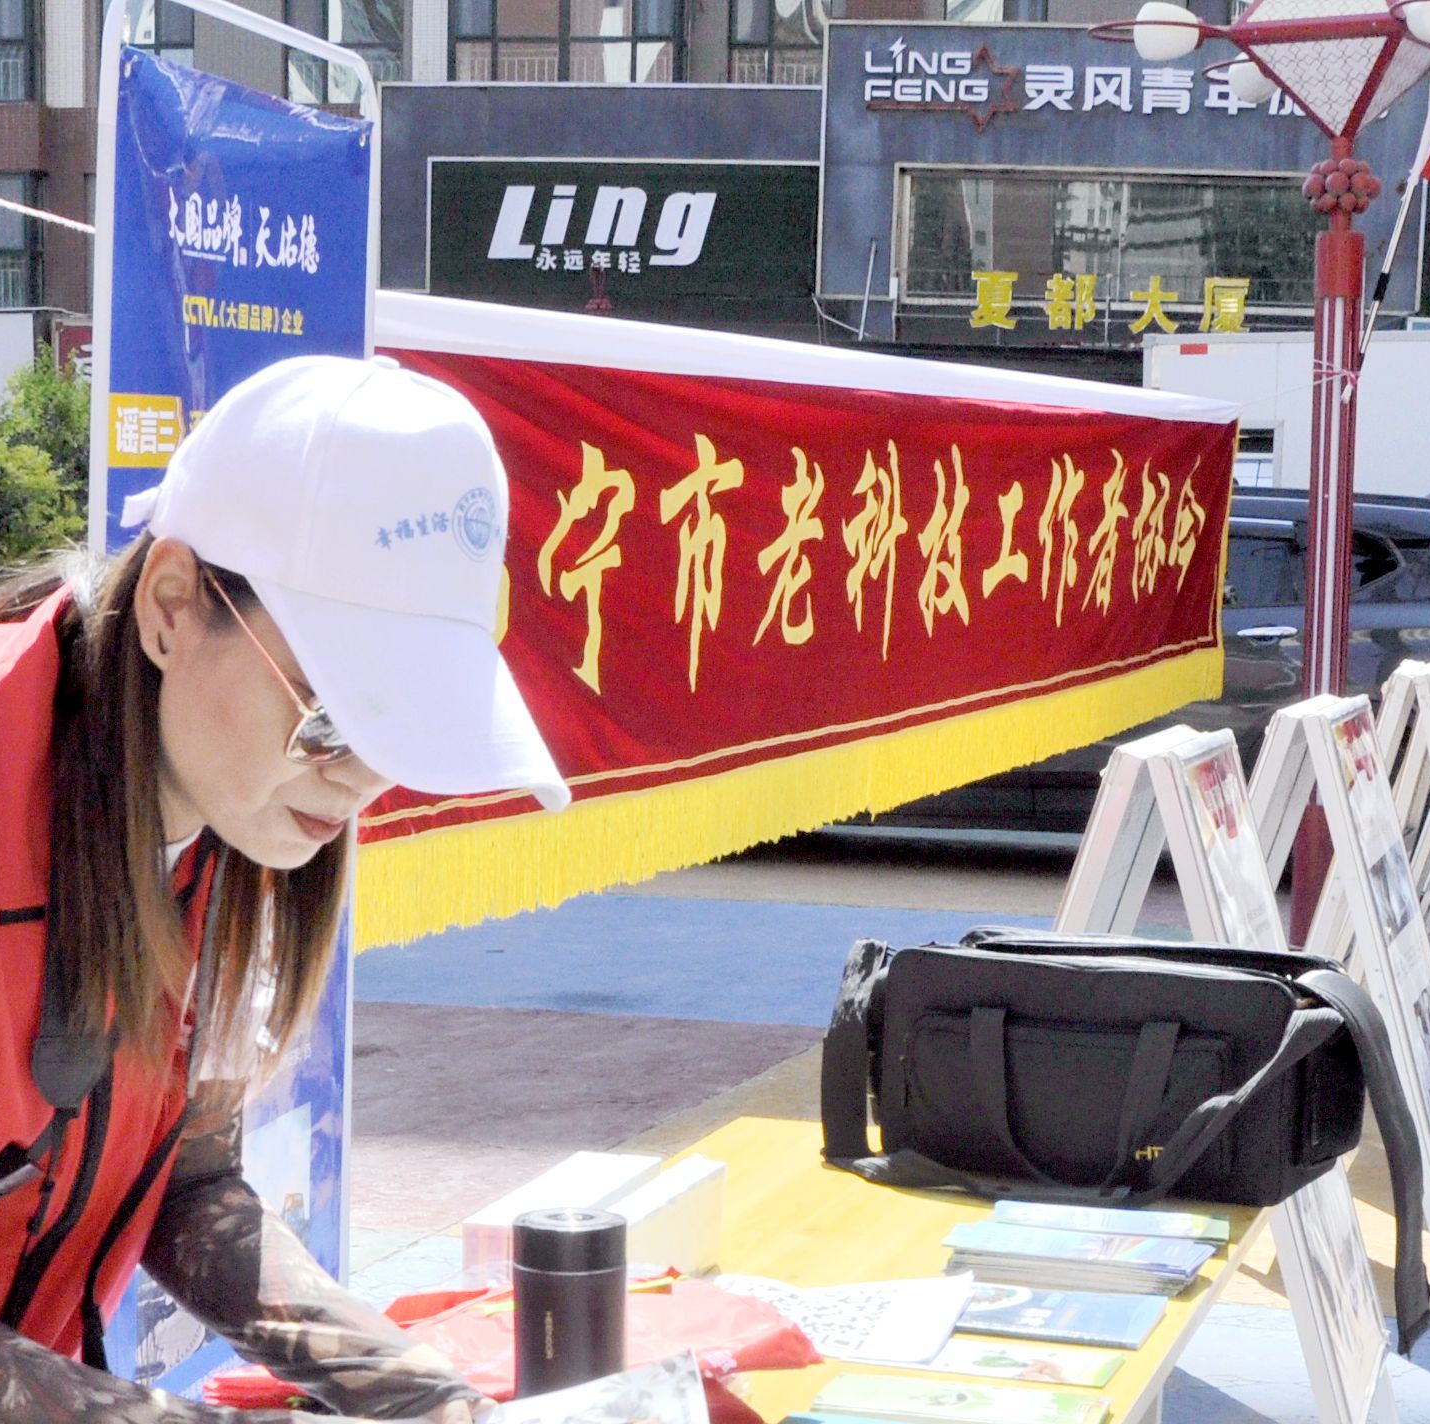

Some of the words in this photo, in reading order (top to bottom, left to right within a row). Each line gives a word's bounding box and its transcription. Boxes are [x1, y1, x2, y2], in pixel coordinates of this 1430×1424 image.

[865, 37, 971, 75] LING
[864, 79, 989, 102] FENG
[256, 206, 320, 274] 天佑德
[487, 185, 718, 266] Ling
[536, 248, 641, 273] 永远年轻
[969, 271, 1250, 333] 夏都大厦
[495, 433, 1206, 695] 宁市老科技工作者协会
